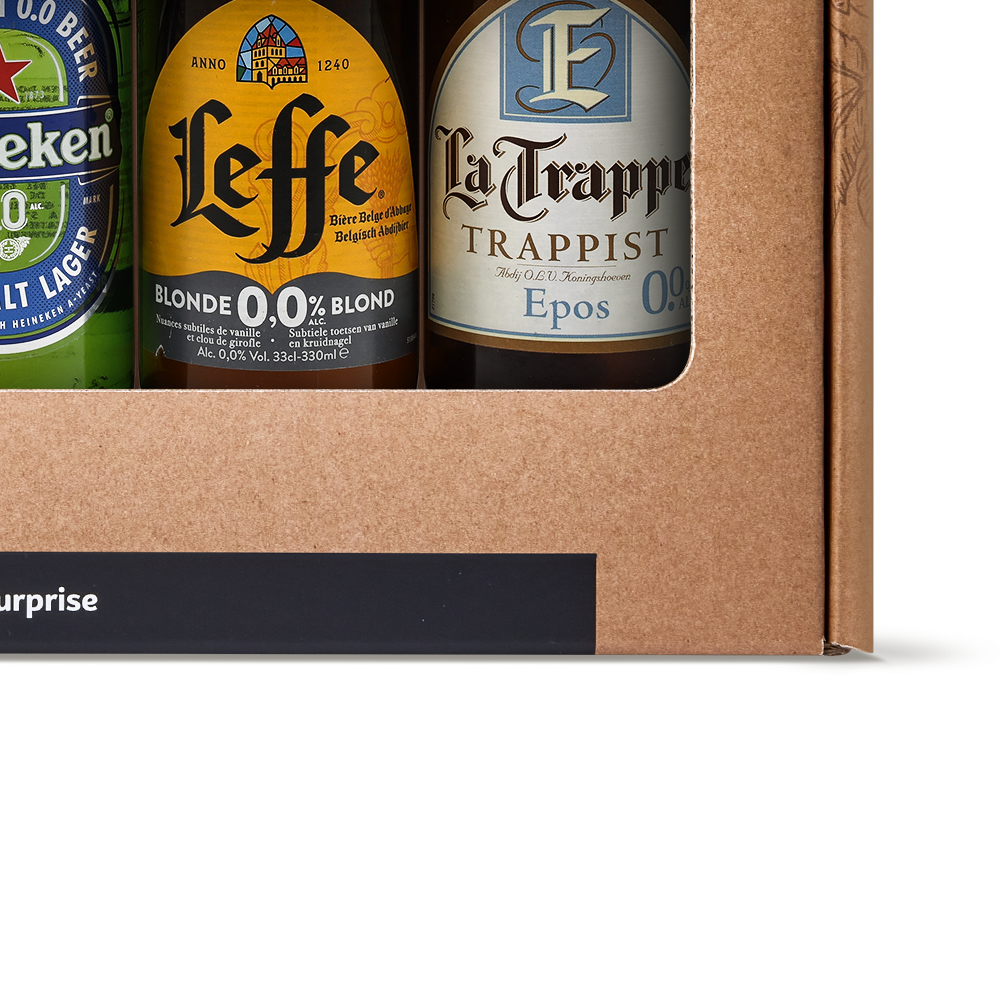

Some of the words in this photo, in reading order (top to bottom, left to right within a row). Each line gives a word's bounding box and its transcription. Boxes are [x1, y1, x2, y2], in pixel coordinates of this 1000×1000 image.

[56, 10, 98, 83] BEER
[191, 56, 226, 70] ANNO
[317, 58, 350, 71] 1240
[24, 90, 45, 100] 1873
[168, 93, 380, 264] Leffe
[435, 125, 497, 220] La
[493, 133, 690, 223] Trappe
[83, 194, 101, 205] MARK
[329, 214, 357, 226] Bière
[359, 210, 383, 223] Belge
[335, 227, 376, 244] Belgisch
[461, 224, 668, 262] TRAPPIST
[38, 225, 98, 300] LAGER
[494, 267, 522, 282] Abdij
[558, 271, 631, 285] Koningshoeven
[12, 305, 64, 329] HEINEKEN
[68, 271, 98, 308] A-YEAST
[155, 283, 232, 316] BLONDE
[331, 289, 395, 315] BLOND
[523, 287, 610, 330] Epos
[679, 296, 690, 309] AL
[155, 314, 182, 330] Nuances
[183, 320, 215, 336] subtiles
[216, 326, 227, 336] de
[229, 327, 261, 338] vanille
[289, 326, 328, 338] Subtiele
[330, 324, 362, 336] toetsen
[363, 323, 376, 332] van
[378, 317, 398, 329] vanille
[187, 334, 195, 342] et
[196, 334, 214, 345] clou
[216, 337, 227, 347] de
[229, 337, 261, 348] girofle
[289, 340, 301, 348] en
[303, 335, 352, 348] kruidnagel
[197, 347, 216, 359] Alc.
[218, 350, 246, 362] 0,0%
[249, 351, 270, 362] Vol.
[273, 350, 337, 362] 33cl-330ml
